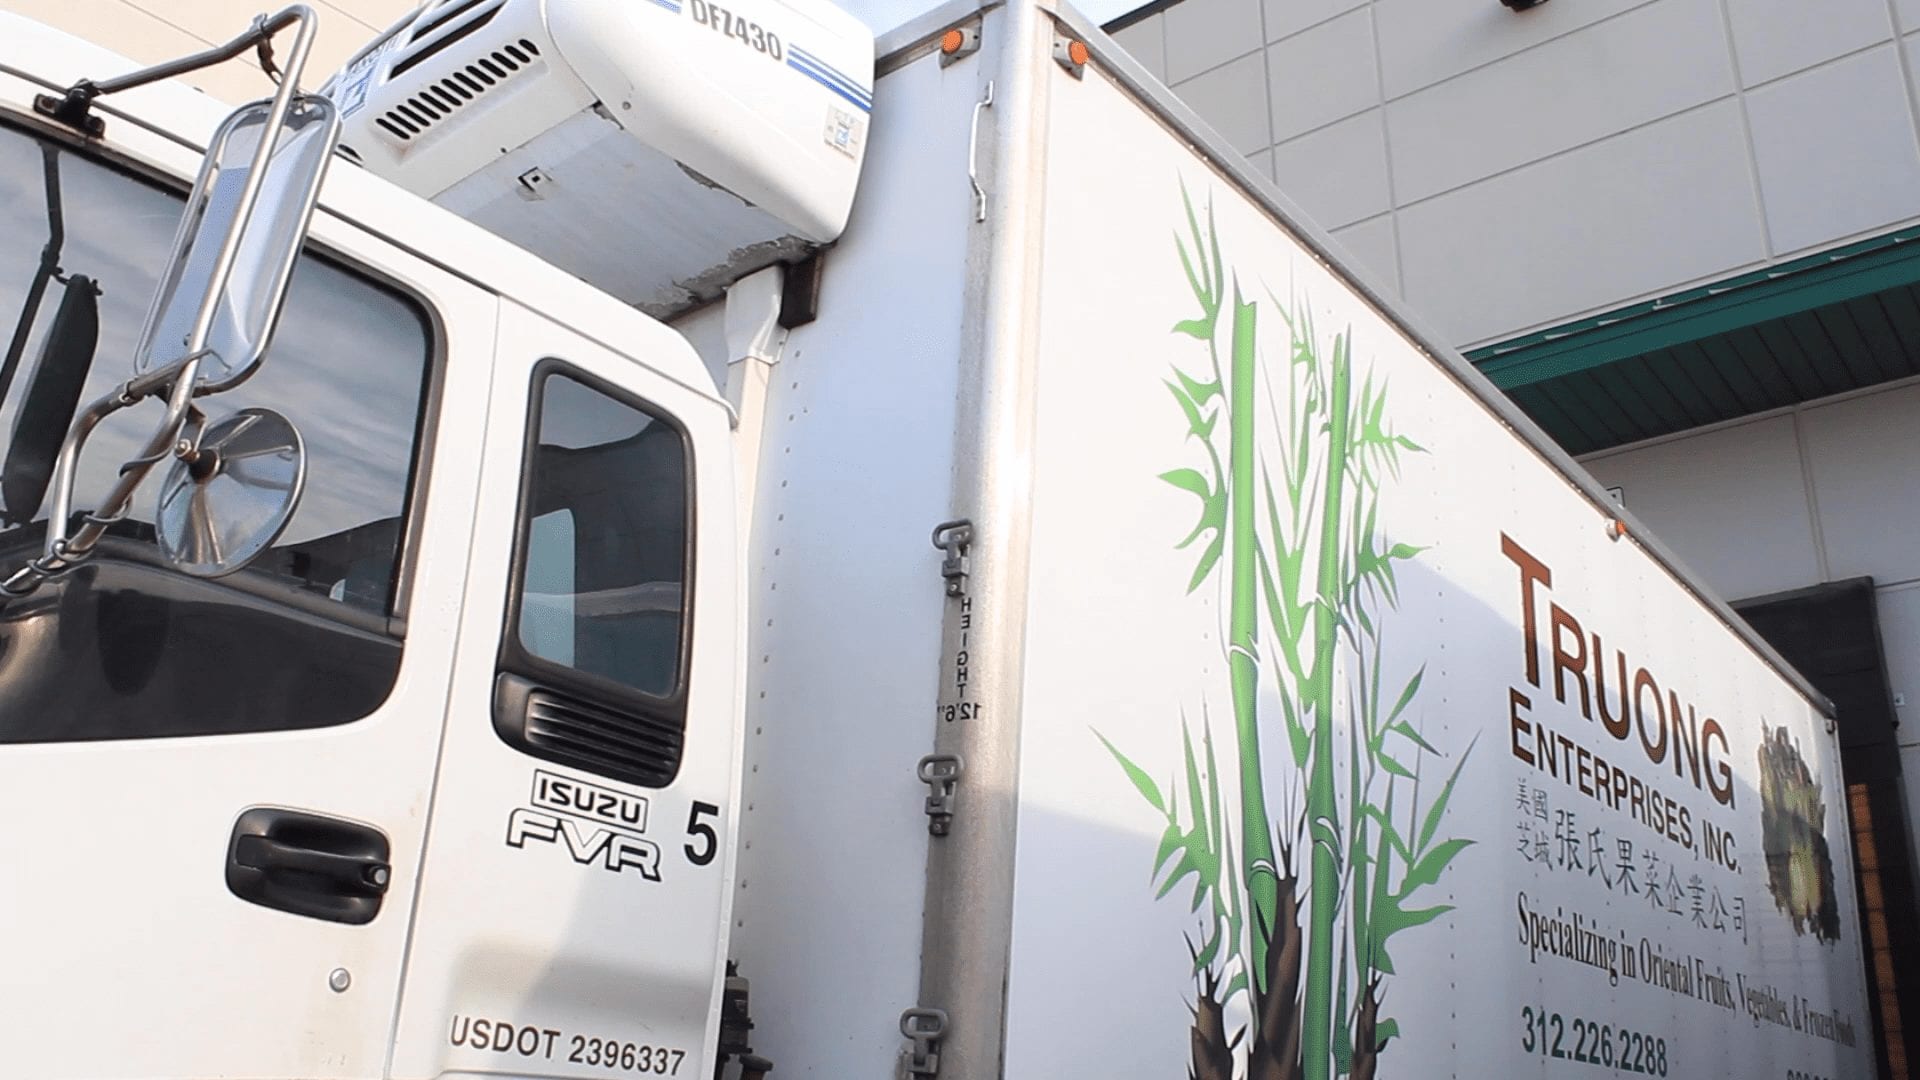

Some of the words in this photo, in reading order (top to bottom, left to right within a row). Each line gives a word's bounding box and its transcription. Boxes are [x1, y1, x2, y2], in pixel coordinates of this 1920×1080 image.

[690, 0, 782, 61] DFZ430
[1500, 531, 1735, 810] TRUONG
[538, 778, 642, 824] ISUZU
[1509, 686, 1698, 860] ENTERPRISES,
[1702, 819, 1742, 875] INC.
[506, 808, 662, 882] FVR
[684, 800, 719, 866] 5
[1518, 892, 1618, 987] Specializing
[1620, 930, 1637, 979] in
[1640, 938, 1694, 998] Oriental
[451, 1014, 561, 1060] USDOT
[568, 1035, 686, 1076] 2396337
[1522, 1006, 1668, 1077] 312.226.2288
